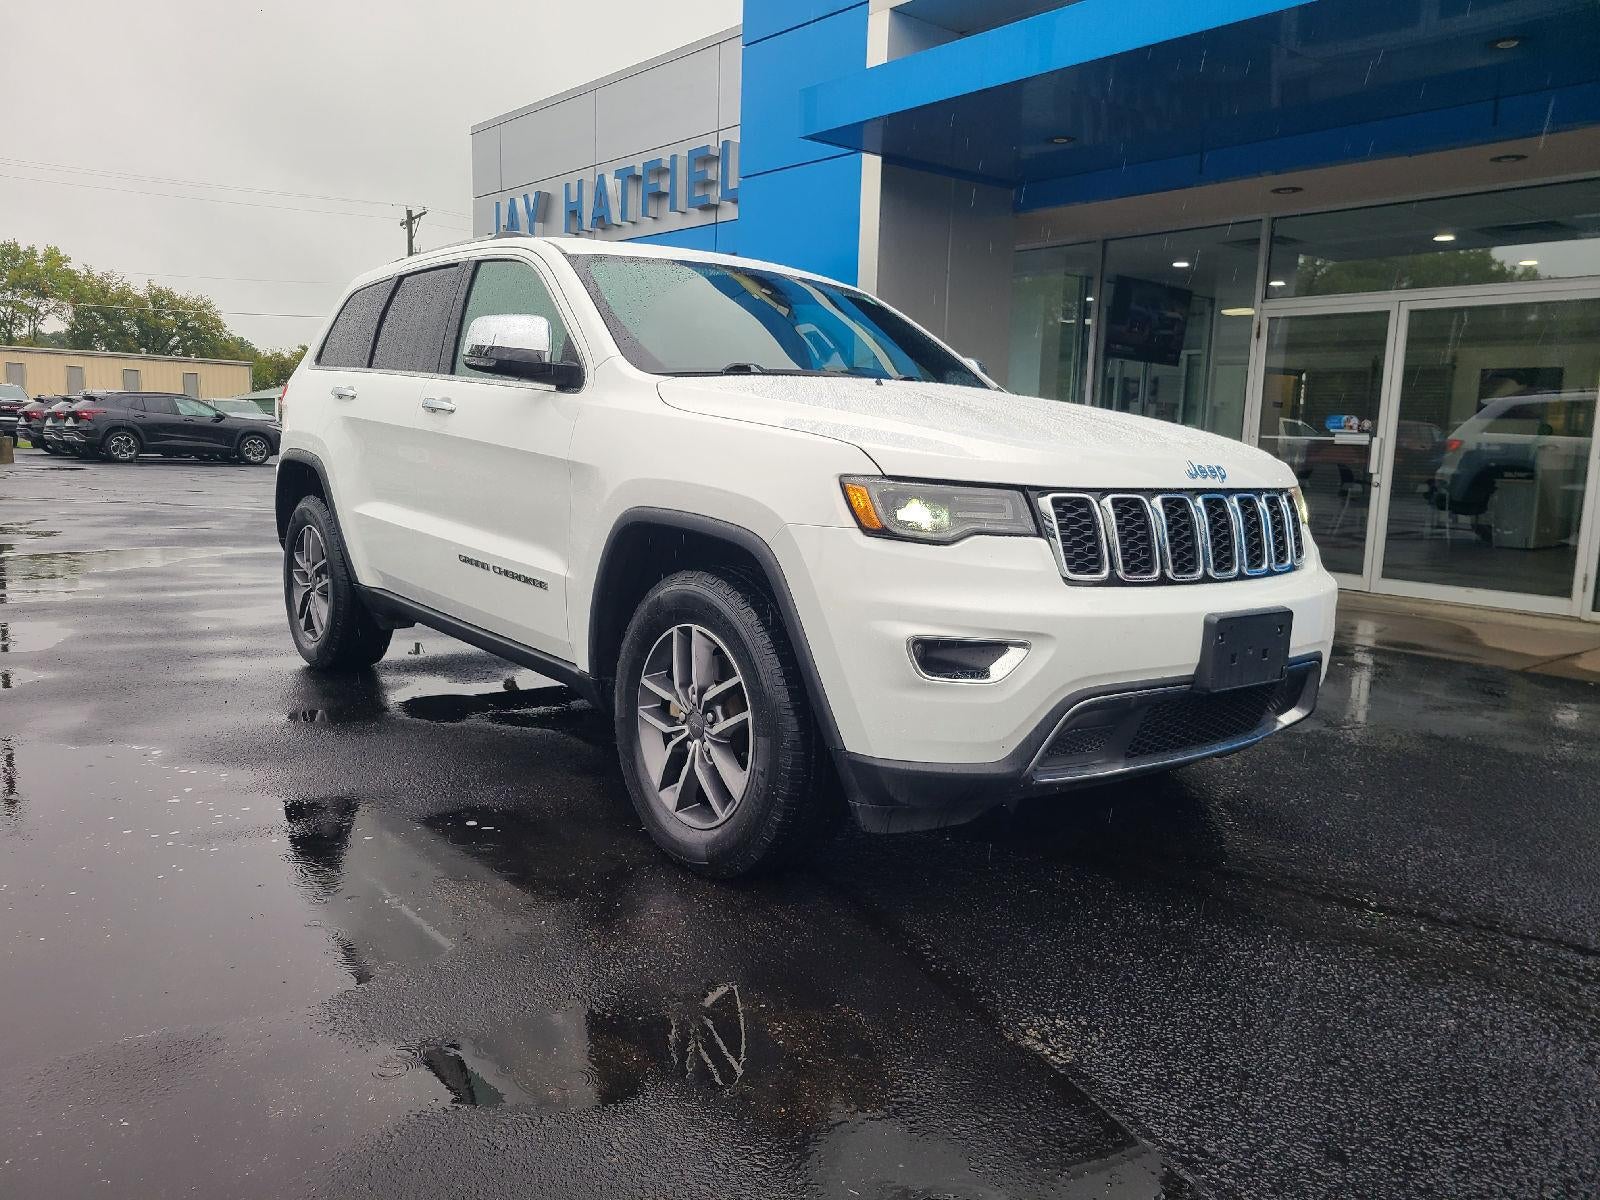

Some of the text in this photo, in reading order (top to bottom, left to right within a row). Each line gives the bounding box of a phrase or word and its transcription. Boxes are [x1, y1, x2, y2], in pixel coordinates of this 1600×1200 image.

[1184, 459, 1227, 484] Jeep
[458, 554, 549, 591] GRAND CHEROKEE
